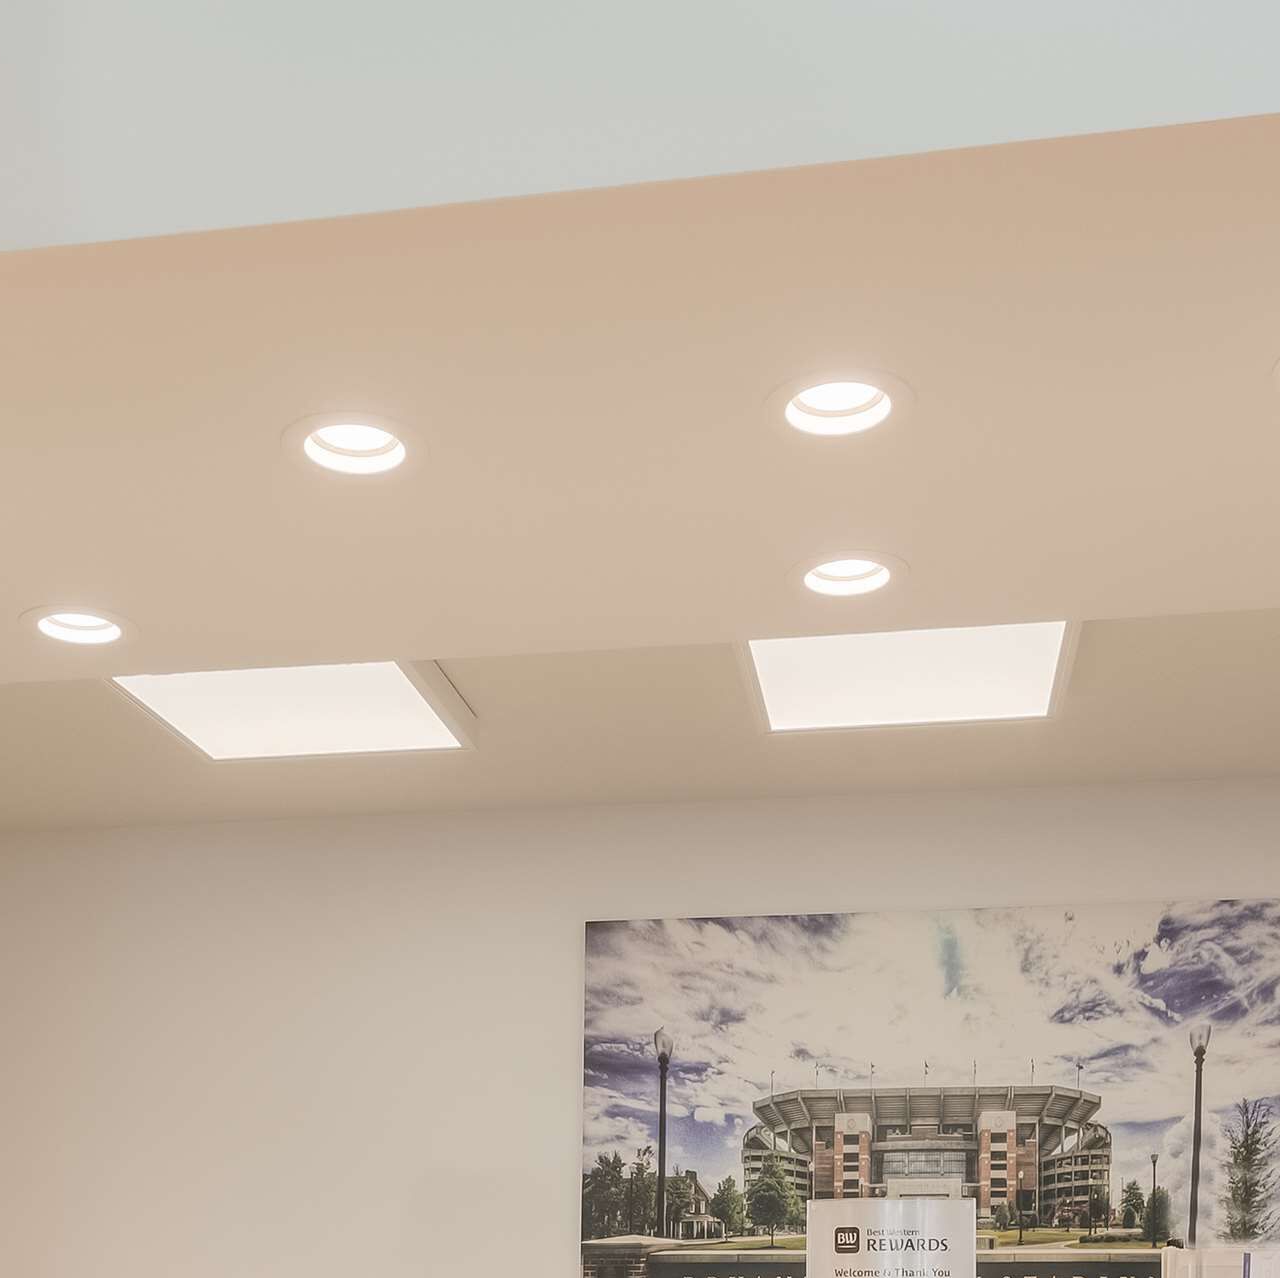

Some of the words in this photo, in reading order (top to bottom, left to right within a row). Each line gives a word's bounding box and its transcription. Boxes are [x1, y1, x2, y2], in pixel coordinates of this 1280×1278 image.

[837, 1232, 858, 1244] BW
[866, 1238, 949, 1251] REWARDS
[834, 1268, 880, 1277] Welcome
[932, 1268, 951, 1277] You
